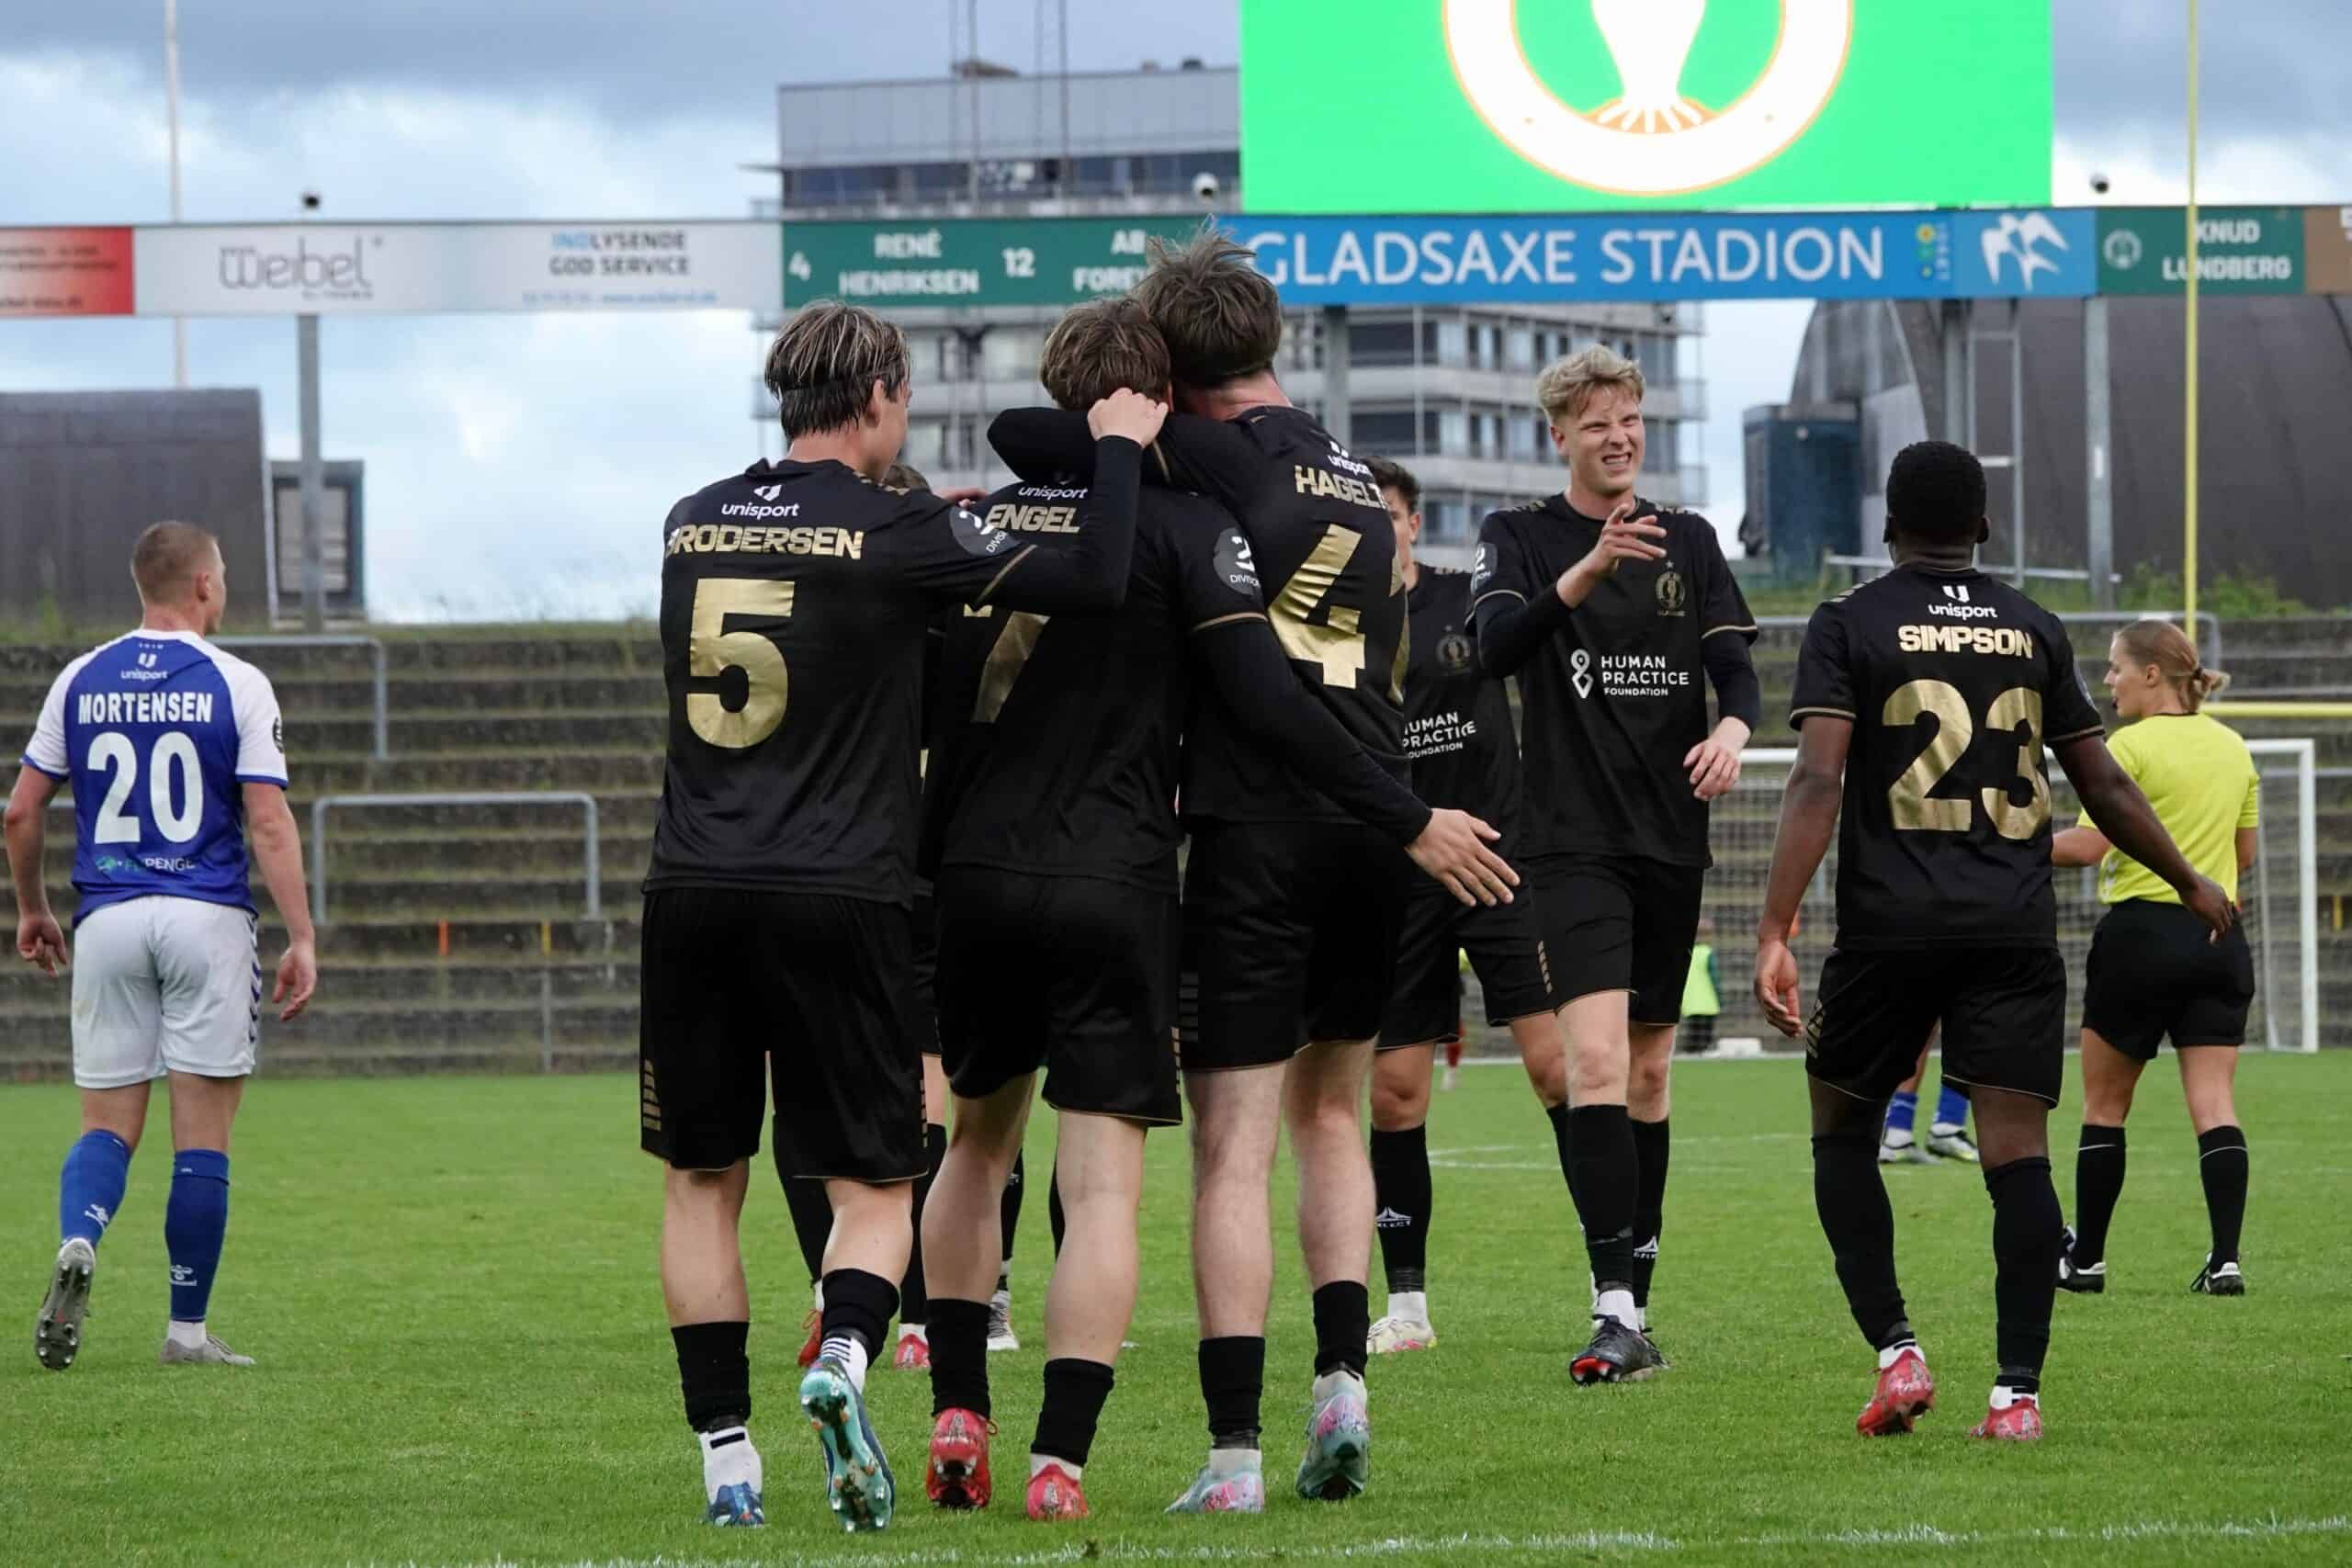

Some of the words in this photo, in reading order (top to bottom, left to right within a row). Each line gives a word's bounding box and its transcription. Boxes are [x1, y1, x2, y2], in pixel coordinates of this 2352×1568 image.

[875, 228, 943, 258] RENÉ
[1245, 231, 1577, 285] GLADSAXE
[1600, 227, 1883, 284] STADION
[600, 255, 690, 276] SERVICE
[788, 251, 811, 282] 4
[1002, 246, 1036, 277] 12
[838, 269, 979, 296] HENRIKSEN
[1017, 484, 1089, 502] unisport
[720, 502, 799, 520] unisport
[985, 503, 1081, 535] ENGEL
[1928, 604, 1998, 620] unisport
[1897, 625, 2033, 659] SIMPSON
[120, 668, 168, 682] unisport
[686, 578, 796, 750] 5
[1600, 655, 1666, 670] HUMAN
[1601, 671, 1690, 685] PRACTICE
[1603, 687, 1669, 696] FOUNDATION
[78, 692, 213, 725] MORTENSEN
[1408, 741, 1463, 759] OUNDATION
[1882, 679, 2052, 840] 23
[87, 731, 204, 844] 20
